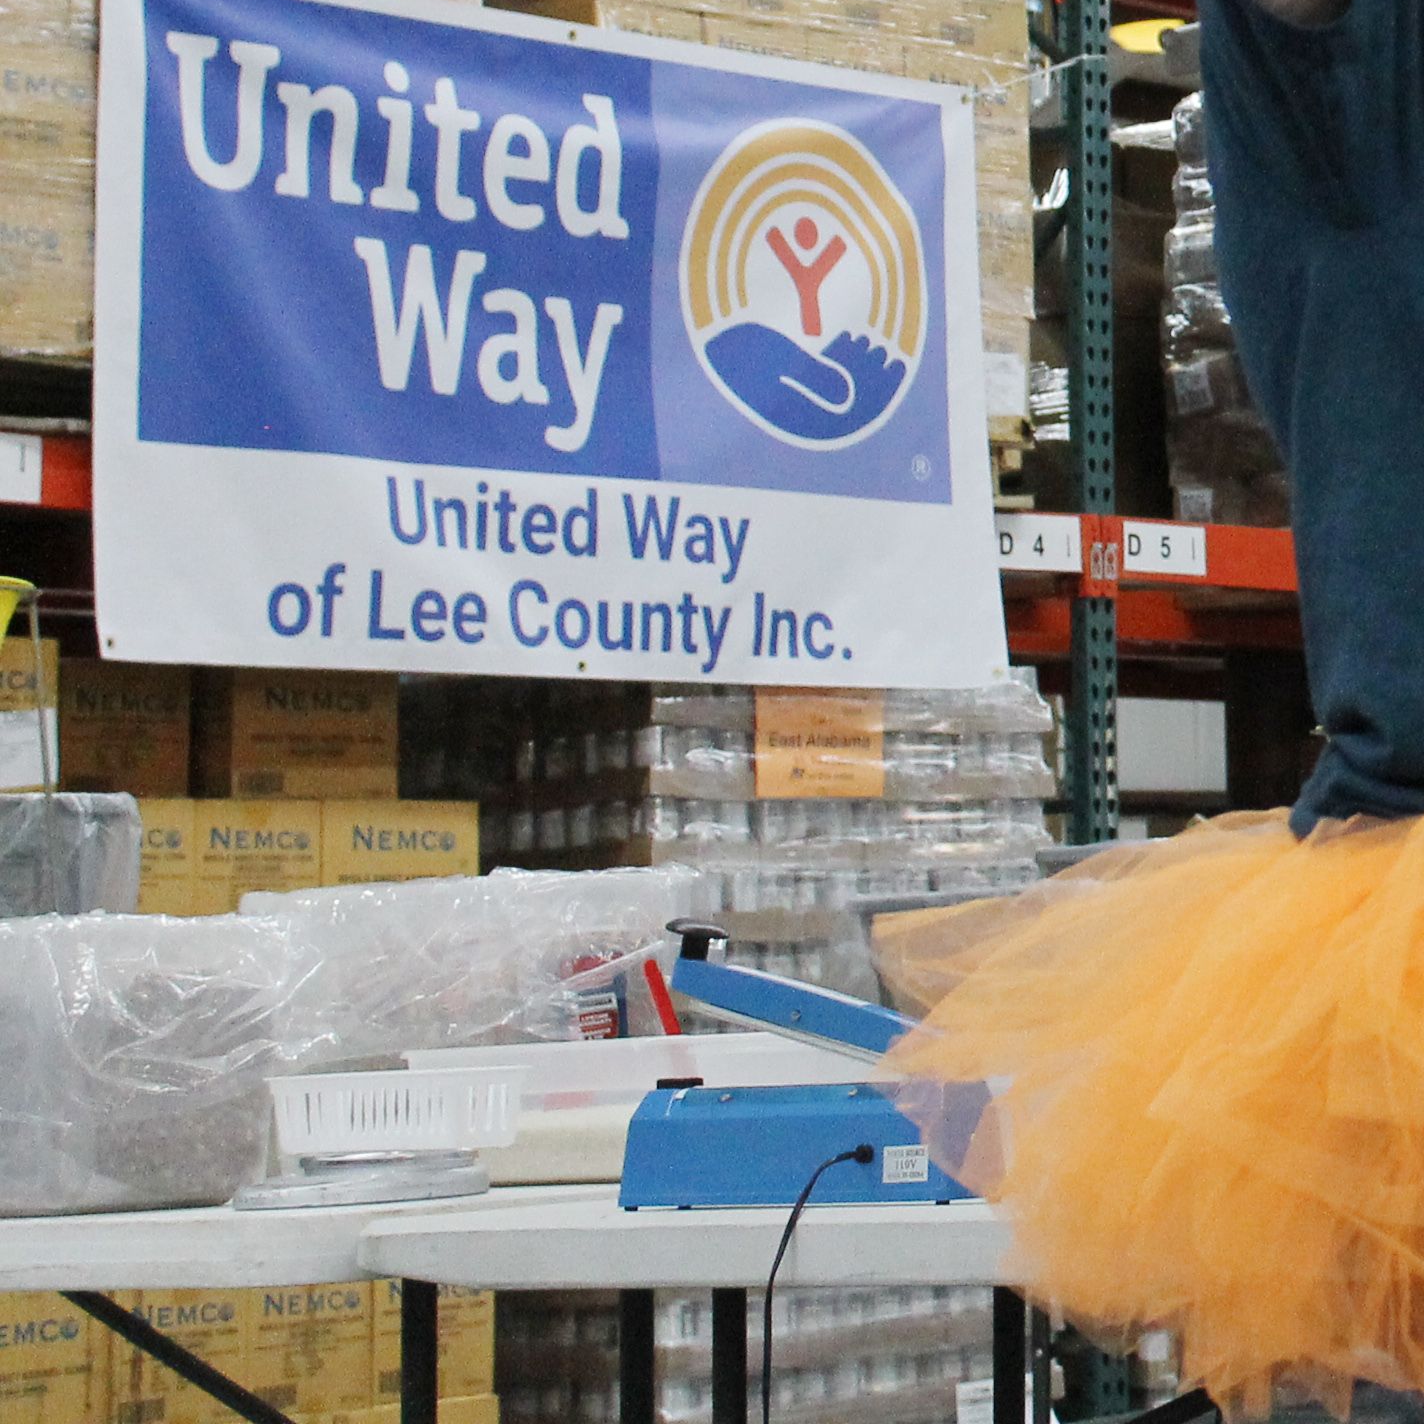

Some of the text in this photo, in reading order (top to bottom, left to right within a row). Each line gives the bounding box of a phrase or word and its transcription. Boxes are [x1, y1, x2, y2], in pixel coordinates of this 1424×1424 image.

[165, 30, 628, 238] United
[354, 235, 625, 454] Way
[385, 473, 751, 583] United Way
[999, 533, 1045, 557] D 4
[1127, 533, 1171, 558] D 5
[267, 563, 854, 676] of Lee County Inc.
[209, 826, 310, 850] NEMCO
[352, 824, 456, 852] NEMCO
[264, 1290, 360, 1317] NEMCO
[0, 1318, 80, 1349] EMCO
